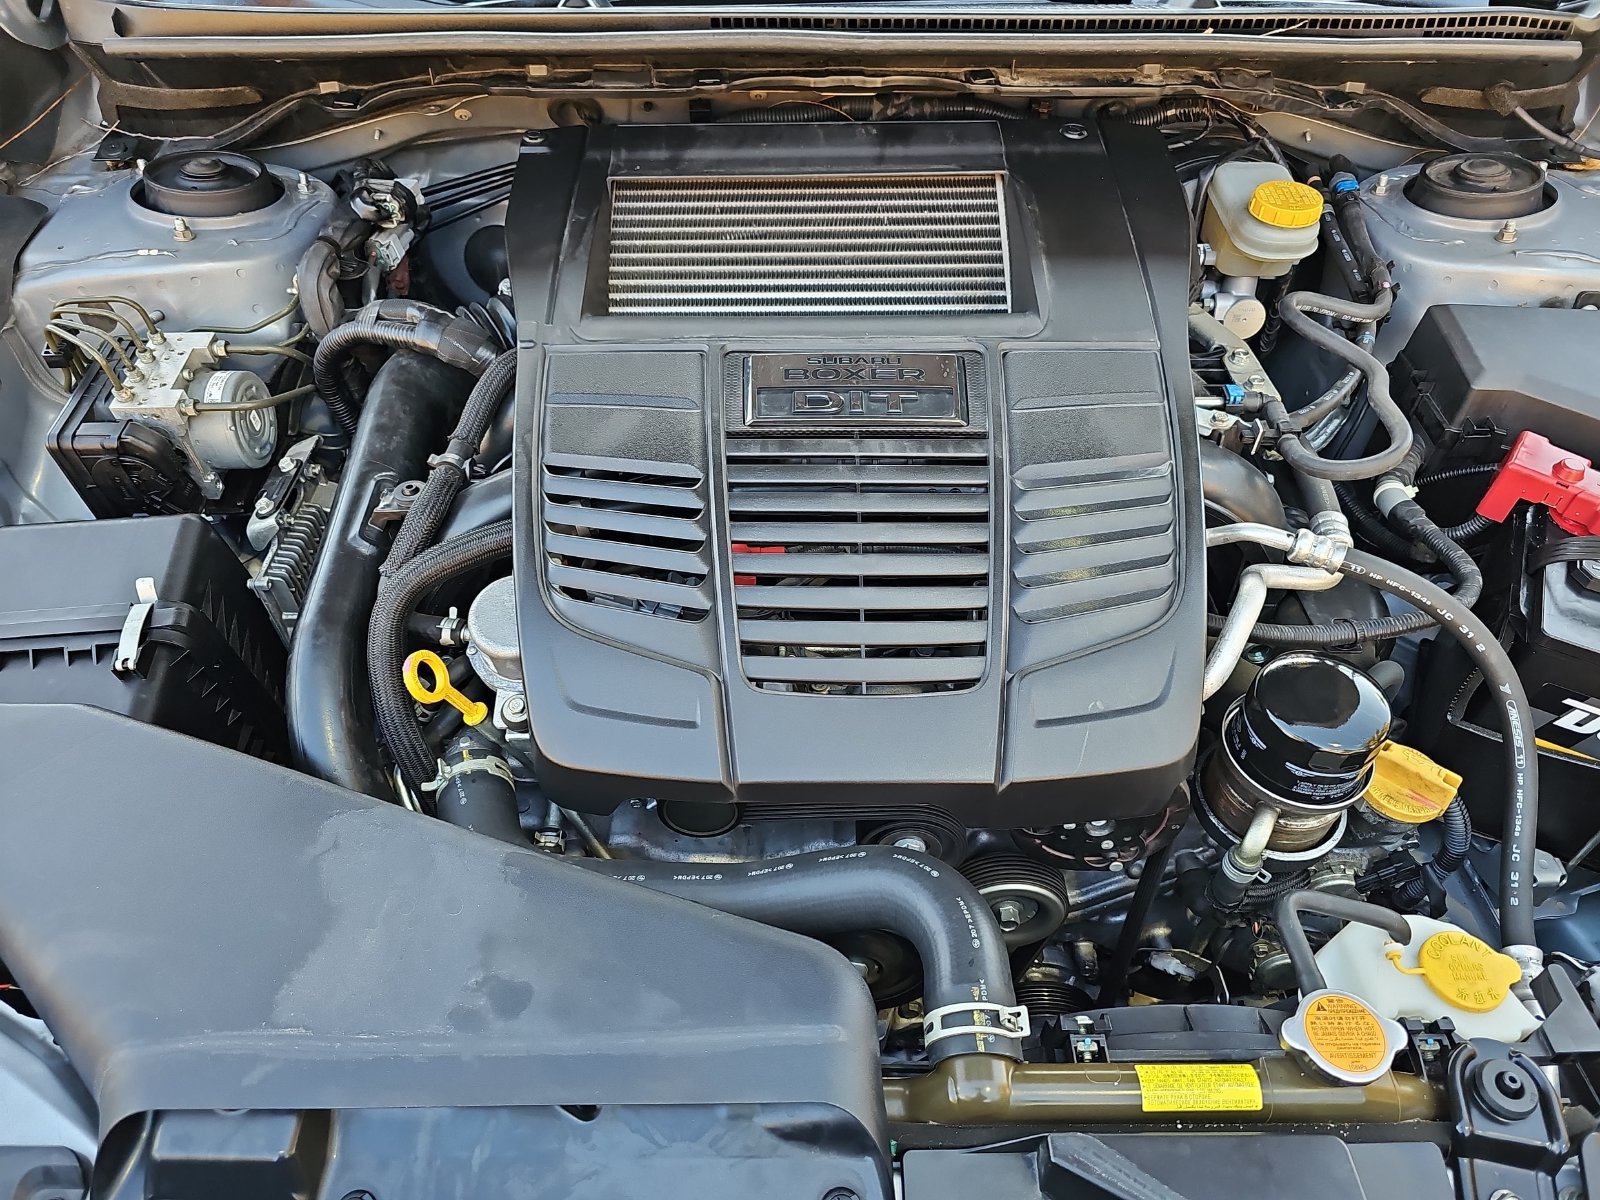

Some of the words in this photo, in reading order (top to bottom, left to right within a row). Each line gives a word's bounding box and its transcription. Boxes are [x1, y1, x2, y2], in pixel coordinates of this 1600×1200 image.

[806, 356, 903, 366] SUBARU
[783, 368, 926, 382] BOXER
[792, 390, 919, 414] DIT
[1368, 572, 1383, 580] HP
[1436, 608, 1454, 621] JC
[1458, 624, 1475, 639] 31
[1516, 773, 1524, 785] HP
[1511, 844, 1520, 862] JC
[1510, 871, 1519, 888] 31
[968, 924, 978, 939] 207
[1427, 934, 1492, 959] COOLANT
